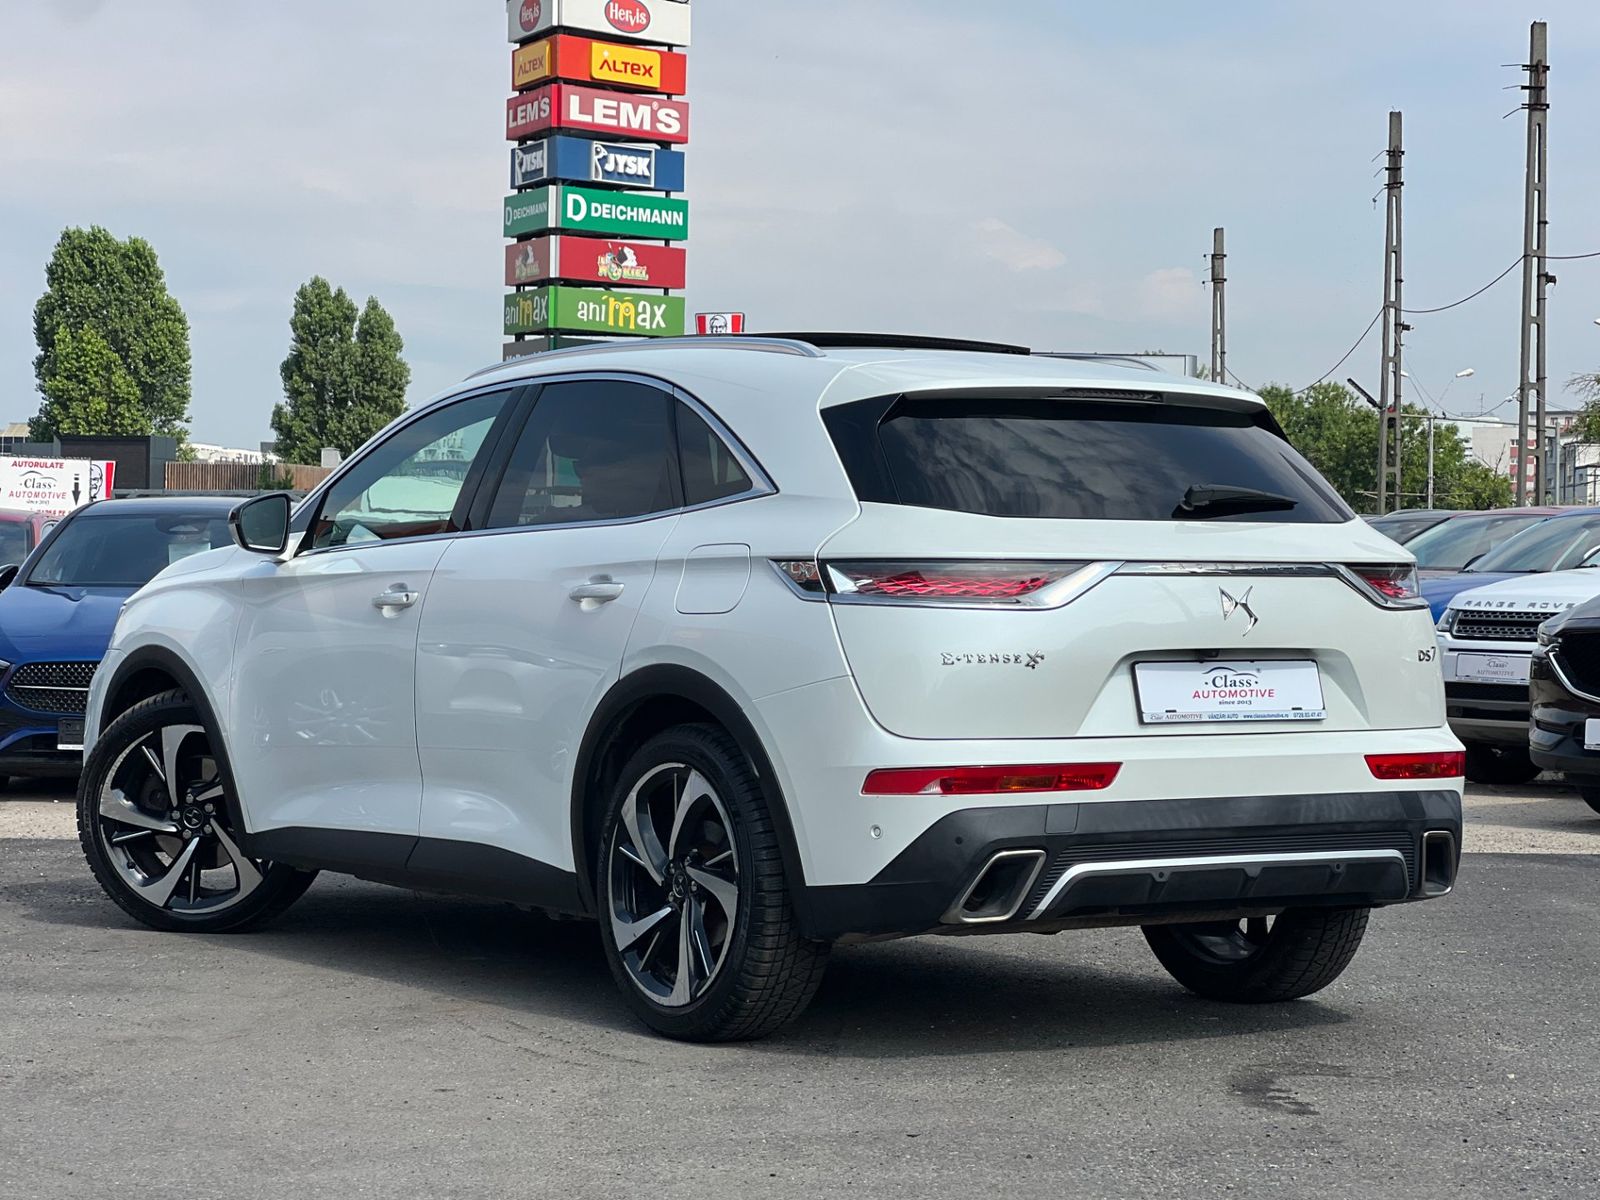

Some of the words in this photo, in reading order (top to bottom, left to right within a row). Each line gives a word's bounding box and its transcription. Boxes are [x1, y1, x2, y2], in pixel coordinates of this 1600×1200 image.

[521, 6, 540, 23] Hervis
[609, 3, 647, 26] Hervis
[508, 96, 550, 128] LEM'S
[569, 95, 681, 134] LEM'S
[522, 149, 544, 173] JYSK
[604, 153, 651, 177] JYSK
[513, 201, 548, 219] DEICHMANN
[590, 202, 683, 226] DEICHMANN
[577, 296, 666, 330] animax
[12, 460, 65, 469] AUTORULATE
[23, 477, 52, 489] Class
[9, 490, 67, 500] AUTOMOTIVE
[1464, 600, 1516, 608] RANGE
[1212, 675, 1252, 688] Class
[1192, 689, 1275, 699] AUTOMOTIVE
